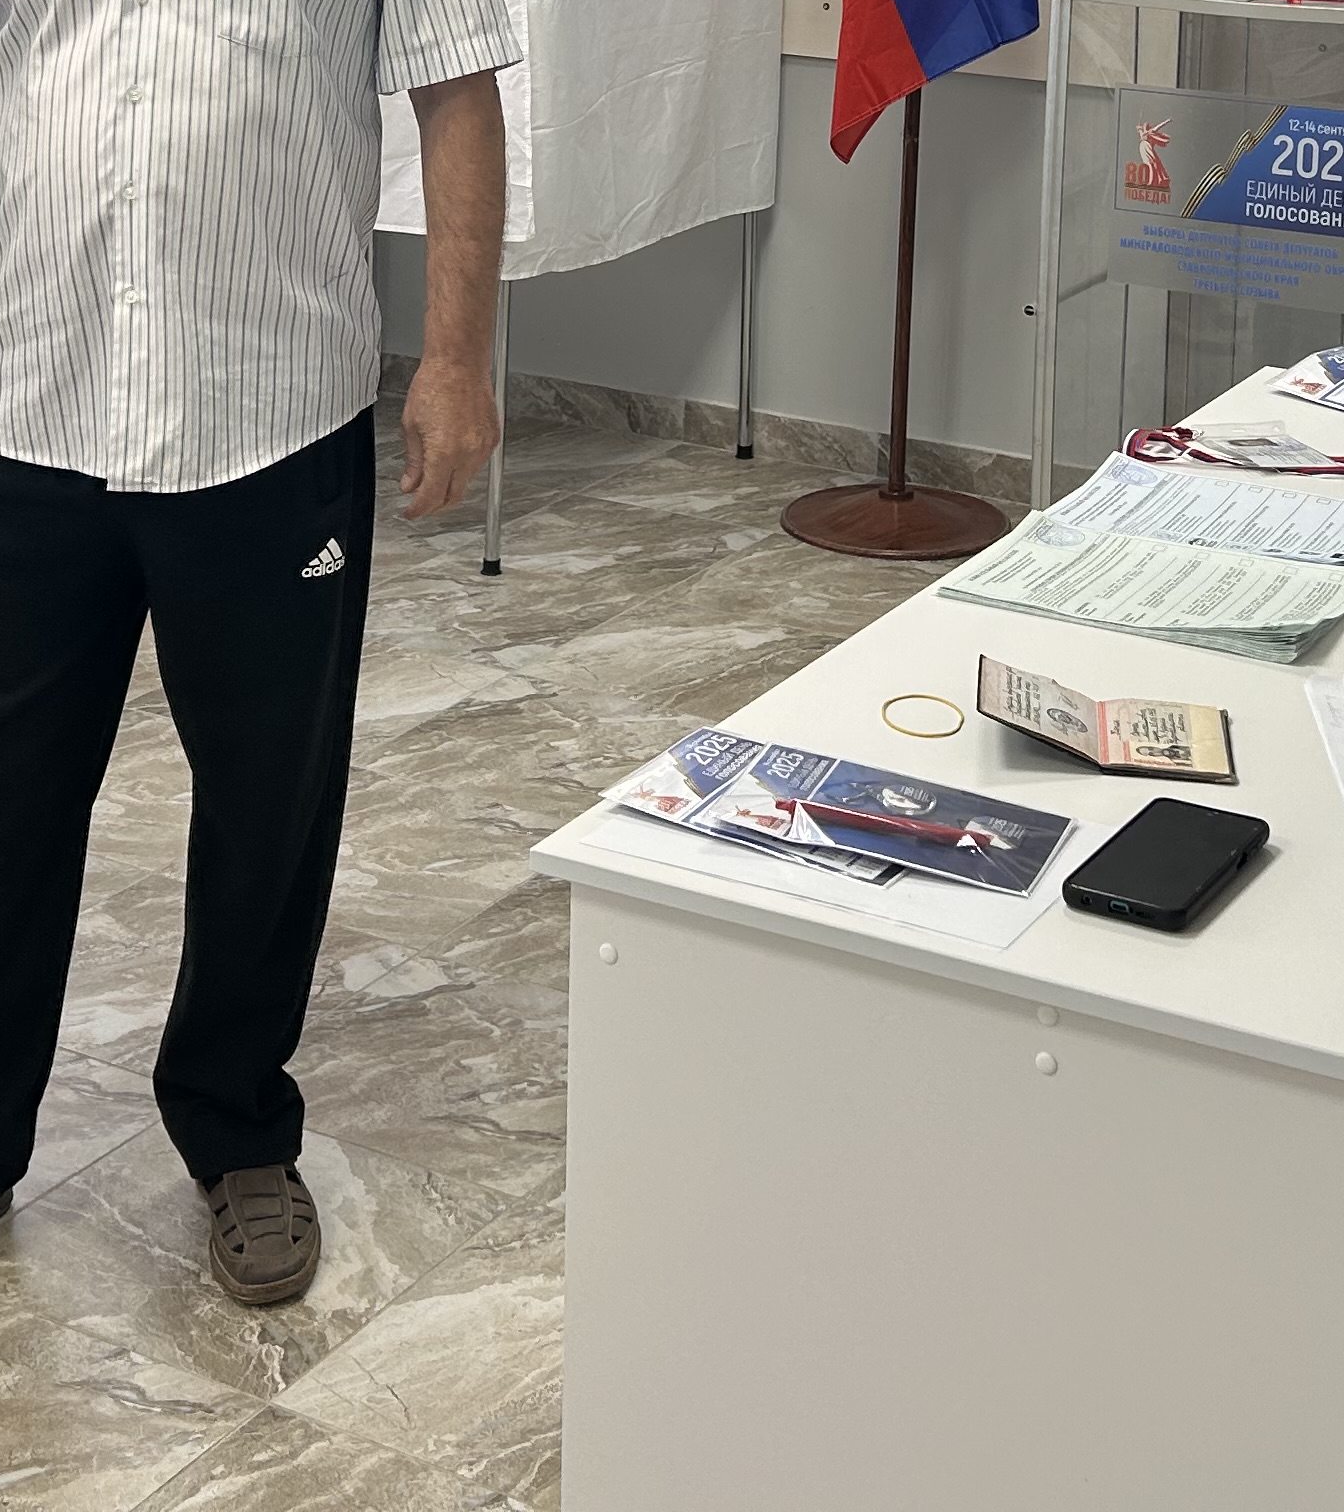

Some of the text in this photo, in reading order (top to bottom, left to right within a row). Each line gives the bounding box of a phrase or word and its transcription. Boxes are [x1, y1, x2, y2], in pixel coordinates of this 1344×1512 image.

[1288, 119, 1316, 133] 12-14
[1246, 180, 1316, 205] ЕДИНЫЙ
[685, 734, 737, 766] 2025
[766, 751, 804, 779] 2025
